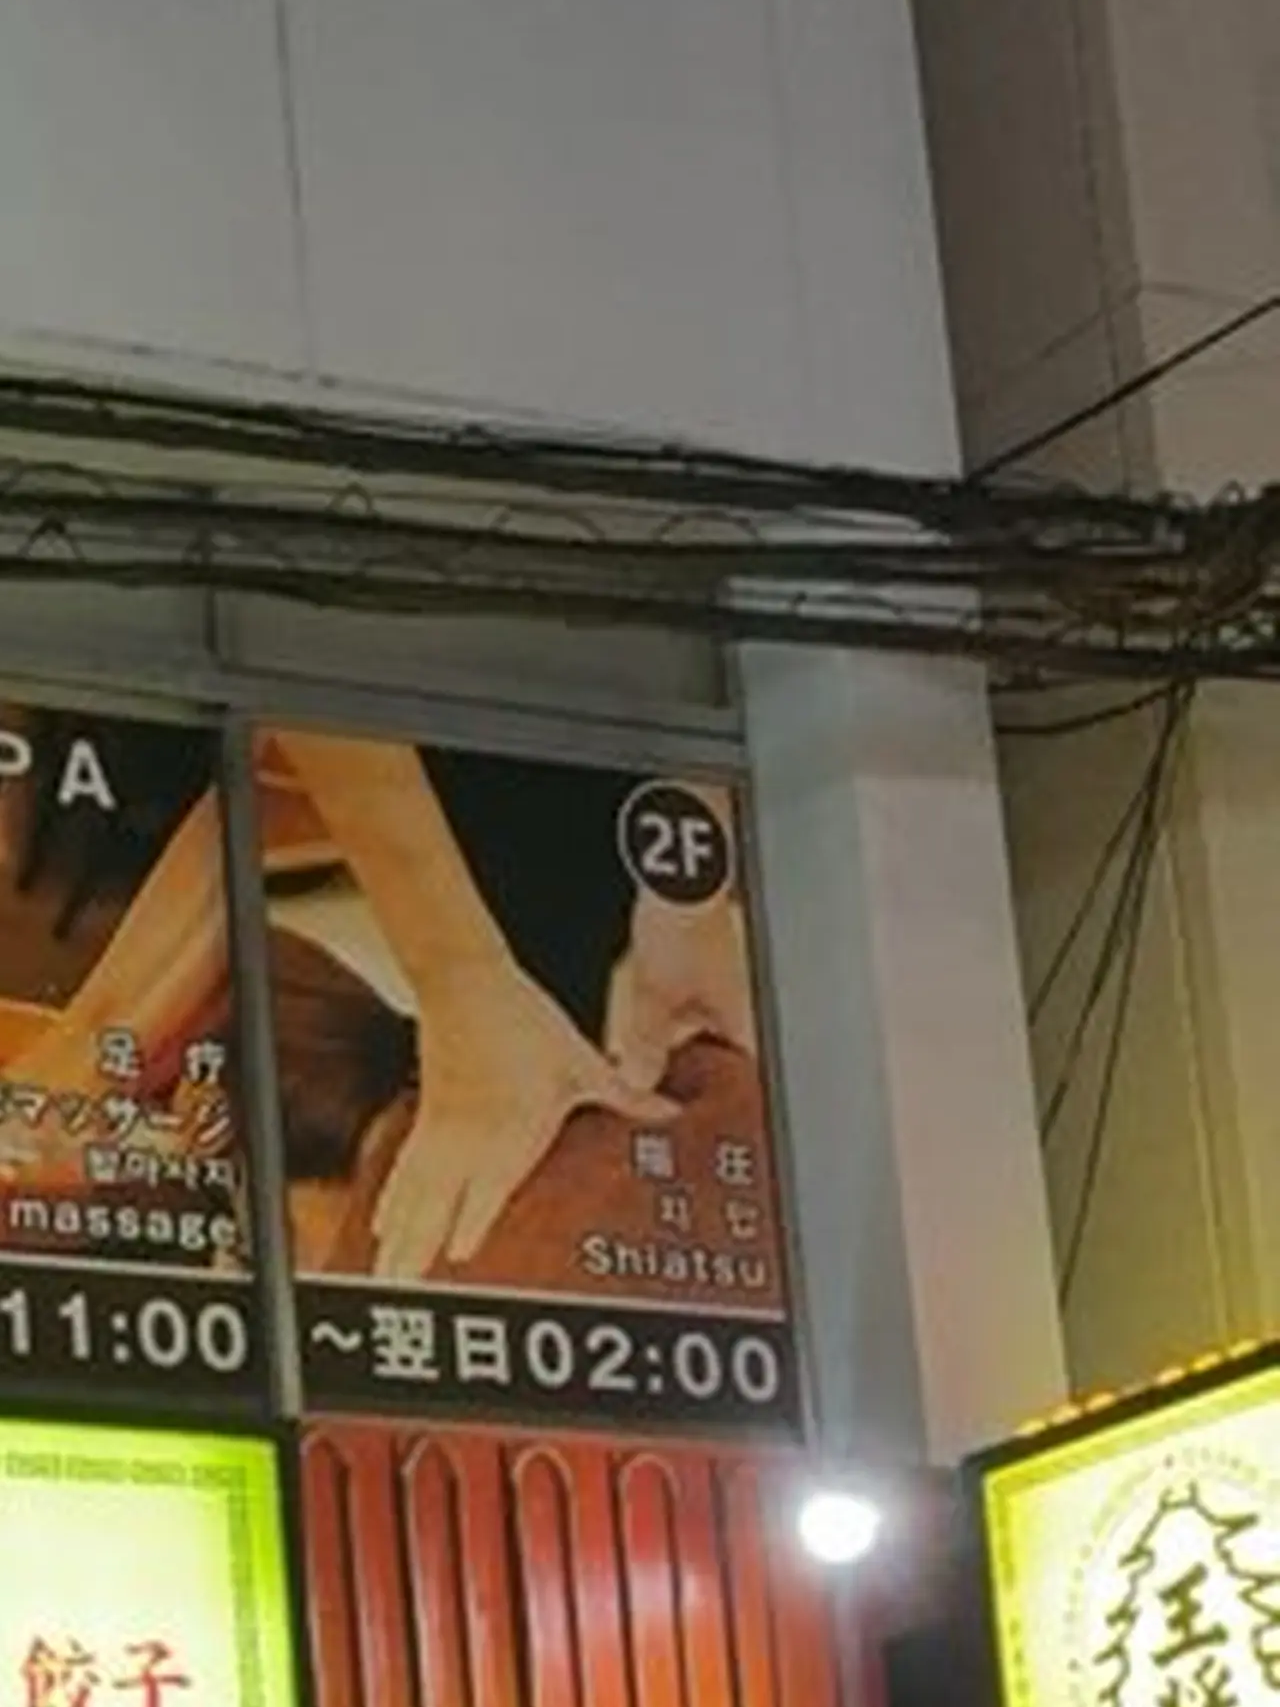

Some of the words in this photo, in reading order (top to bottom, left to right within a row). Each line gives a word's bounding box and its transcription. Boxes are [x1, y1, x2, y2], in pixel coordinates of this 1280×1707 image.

[638, 814, 720, 879] 2F
[10, 1198, 235, 1250] massage
[581, 1233, 768, 1288] Shiatsu
